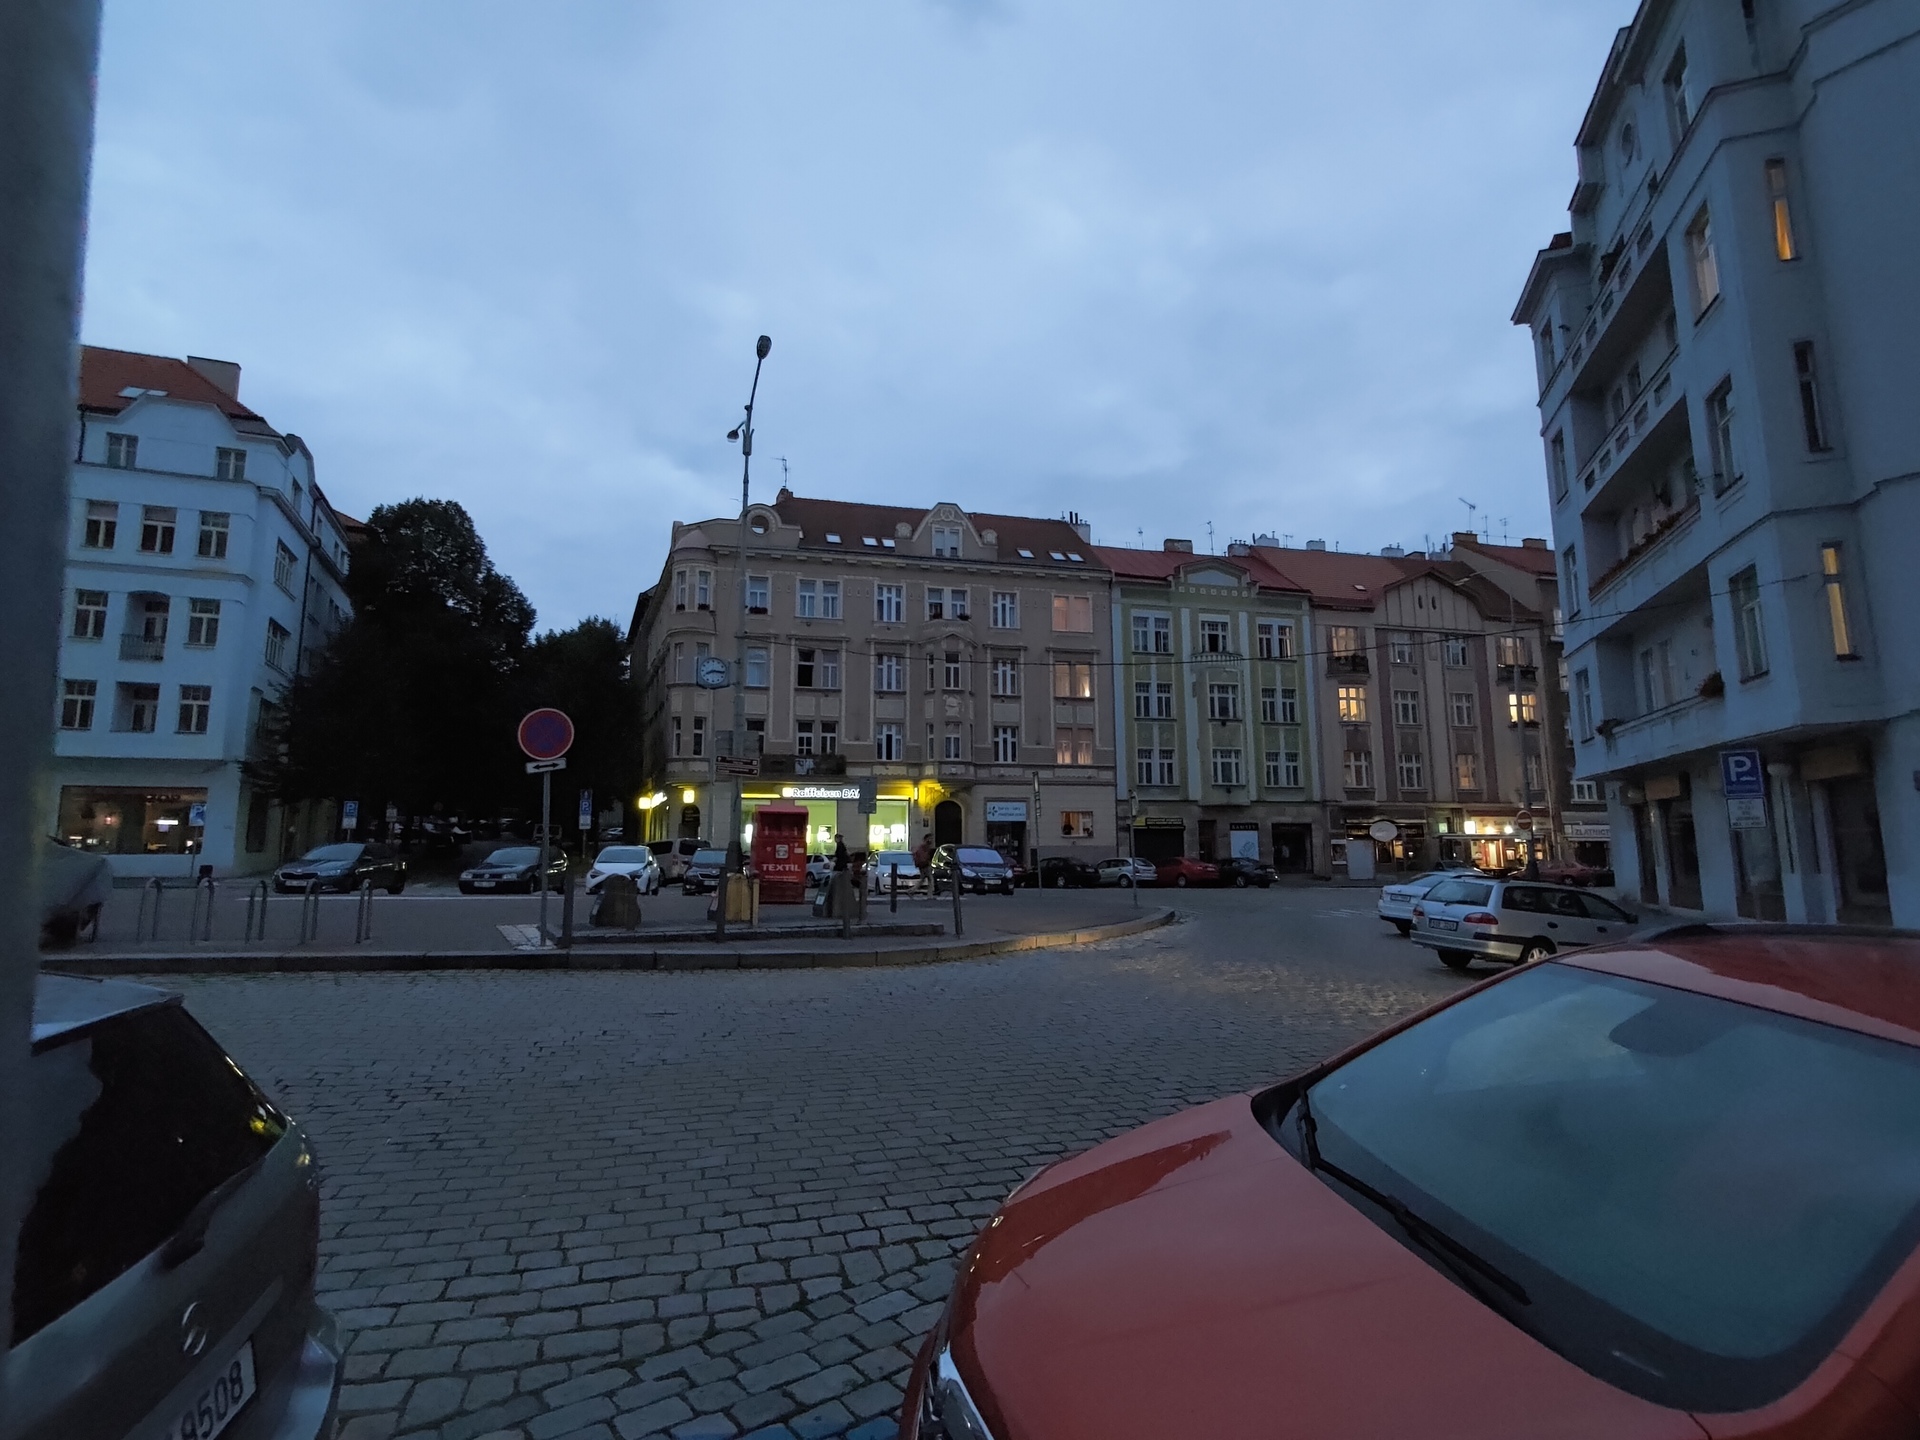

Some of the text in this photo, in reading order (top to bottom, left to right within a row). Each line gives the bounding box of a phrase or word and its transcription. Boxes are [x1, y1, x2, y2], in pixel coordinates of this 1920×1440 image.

[1728, 755, 1752, 782] P
[792, 787, 841, 797] Raiffeisen
[762, 863, 801, 872] TEXTIL
